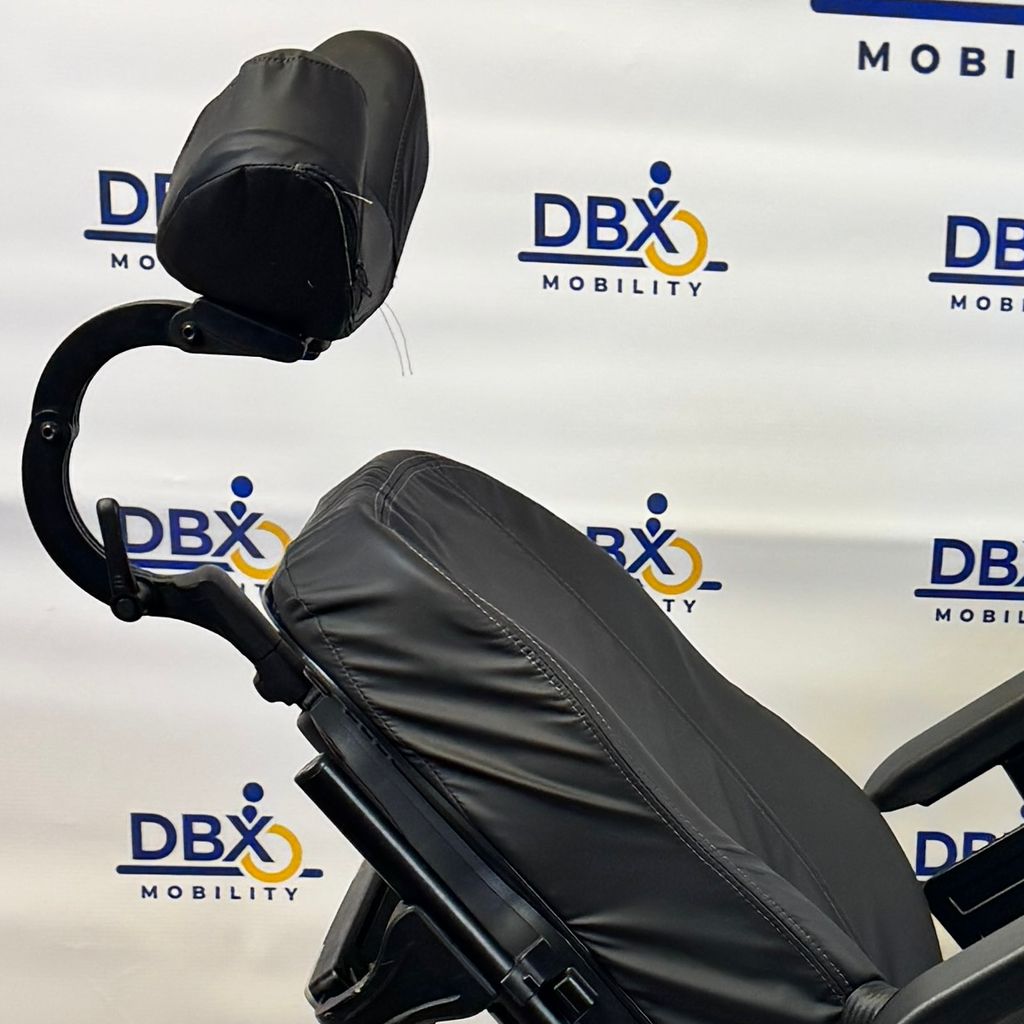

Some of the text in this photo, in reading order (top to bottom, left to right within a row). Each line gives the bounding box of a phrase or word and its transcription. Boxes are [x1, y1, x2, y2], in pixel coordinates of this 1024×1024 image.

[534, 193, 680, 254] DBX
[543, 274, 702, 298] MOBILITY
[119, 506, 264, 559] DBX
[130, 812, 275, 864] DBX
[141, 884, 298, 902] MOBILITY
